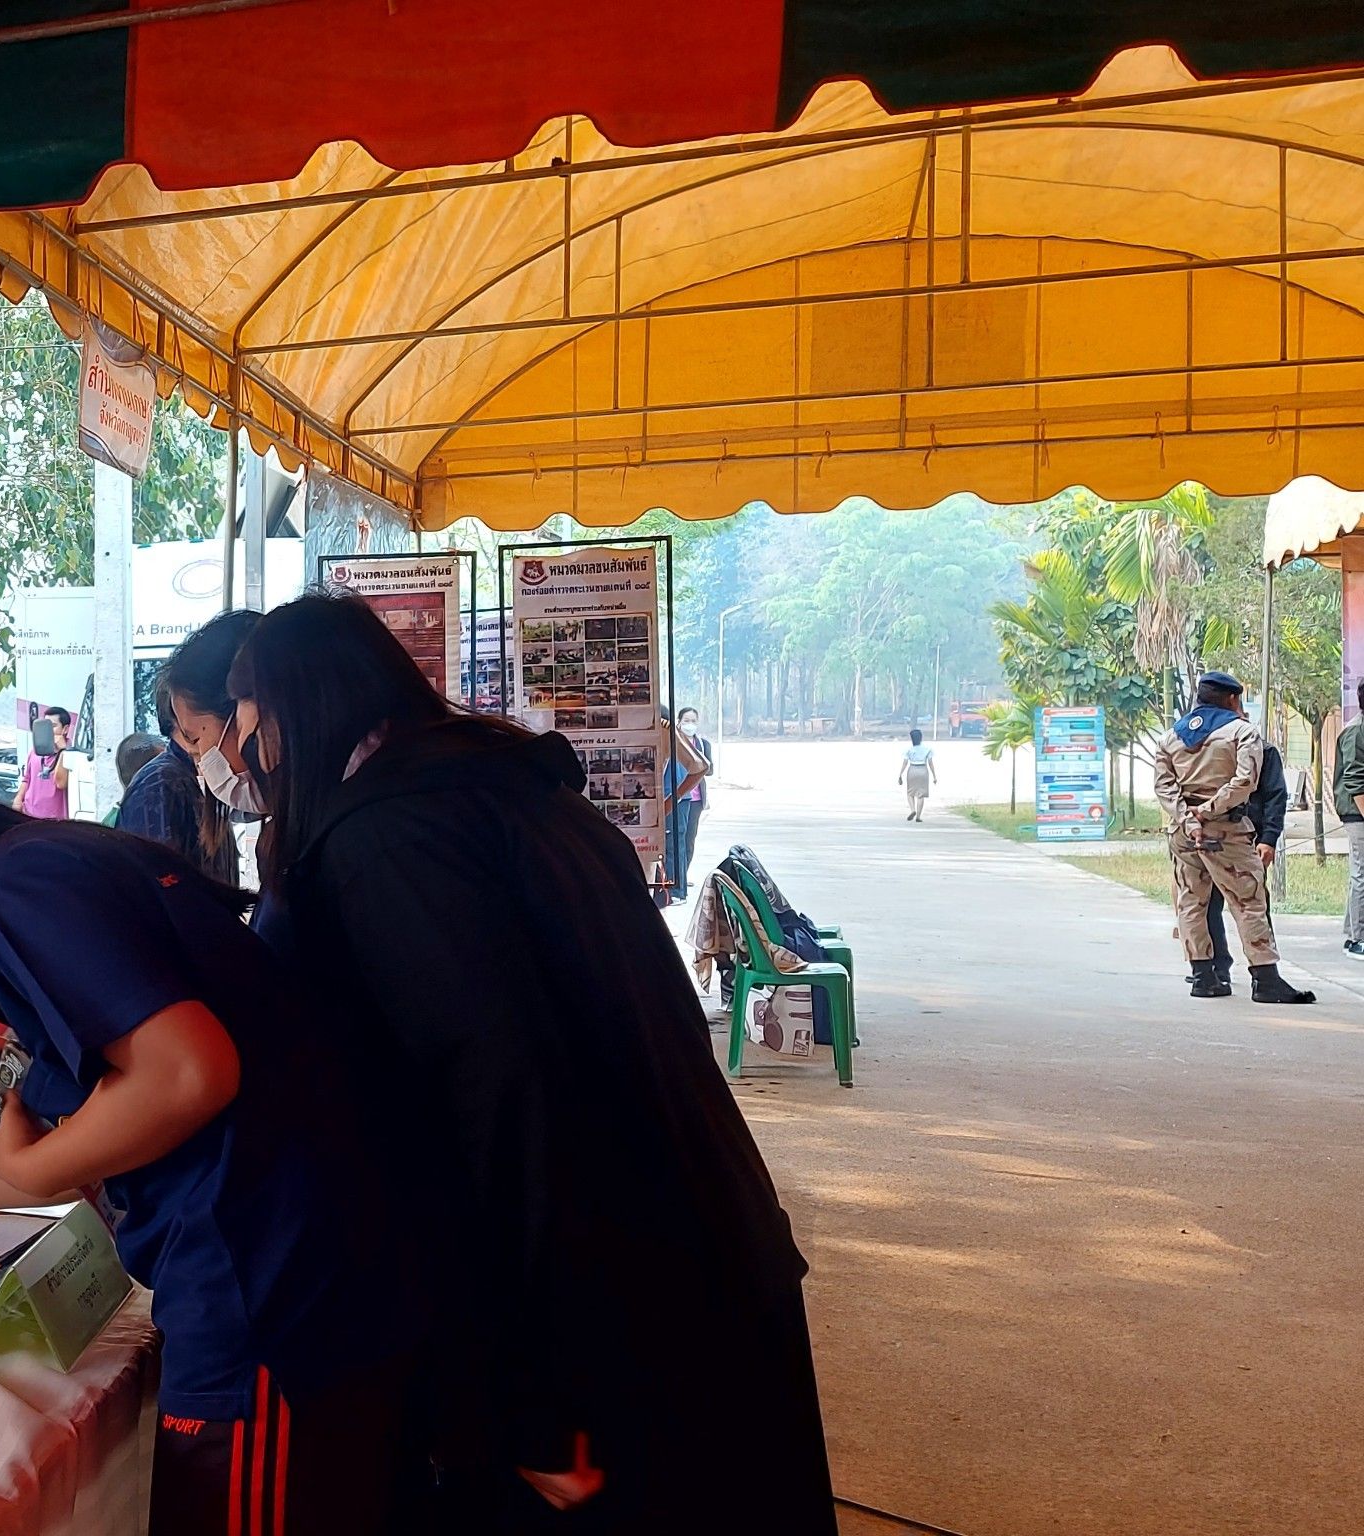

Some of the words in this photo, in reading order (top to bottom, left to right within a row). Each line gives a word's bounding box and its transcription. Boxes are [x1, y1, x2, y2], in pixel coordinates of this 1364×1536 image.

[353, 564, 454, 580] หมวดมวลชนสัมพันธ์
[548, 555, 649, 577] หมวดมวลชนสัมพันธ์
[521, 579, 632, 596] กองร้อยตำรวจตระเวนชายแดนที่
[150, 622, 192, 635] Brand
[163, 1414, 206, 1436] SPORT
